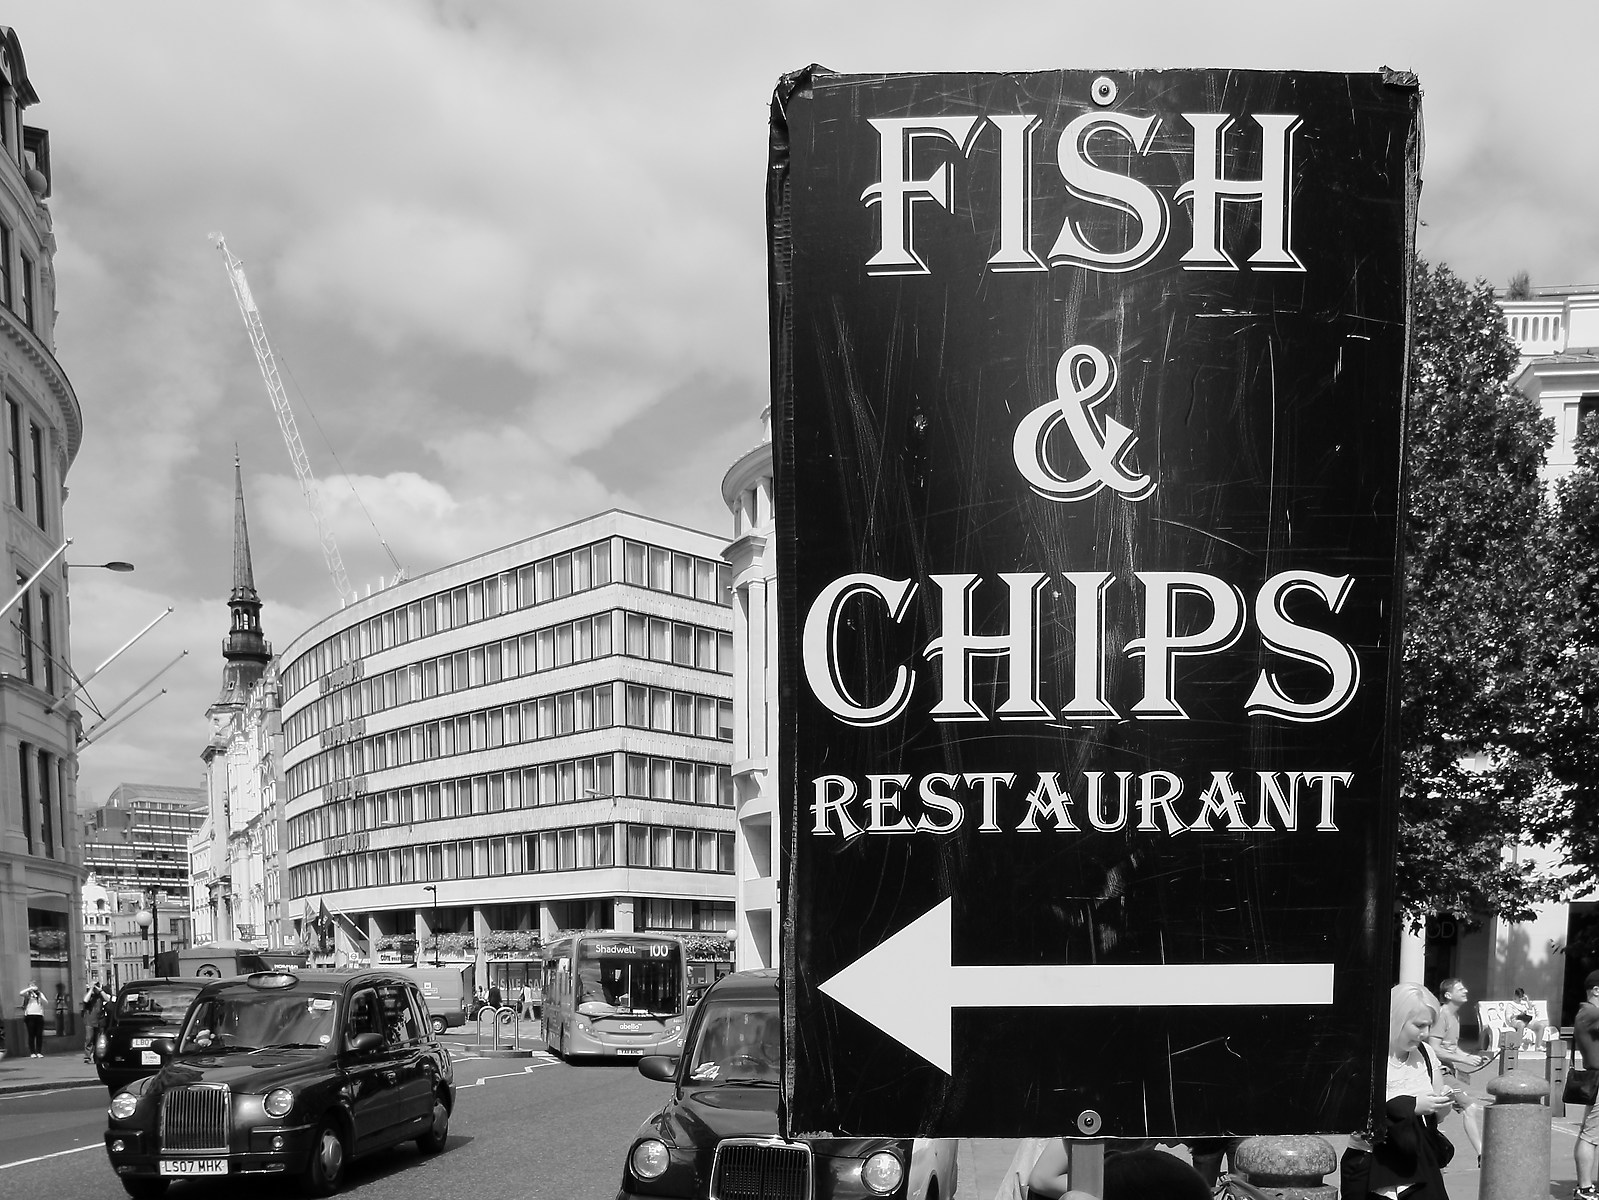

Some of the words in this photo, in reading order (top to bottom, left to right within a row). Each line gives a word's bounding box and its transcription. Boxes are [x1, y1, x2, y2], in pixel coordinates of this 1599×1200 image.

[860, 111, 1307, 275] FISH
[1012, 344, 1158, 502] &
[802, 570, 1361, 727] CHIPS
[810, 770, 1355, 838] RESTAURANT
[595, 944, 637, 954] Shadwell
[649, 945, 669, 957] 100
[164, 1160, 194, 1172] LS07
[198, 1160, 223, 1172] MHK
